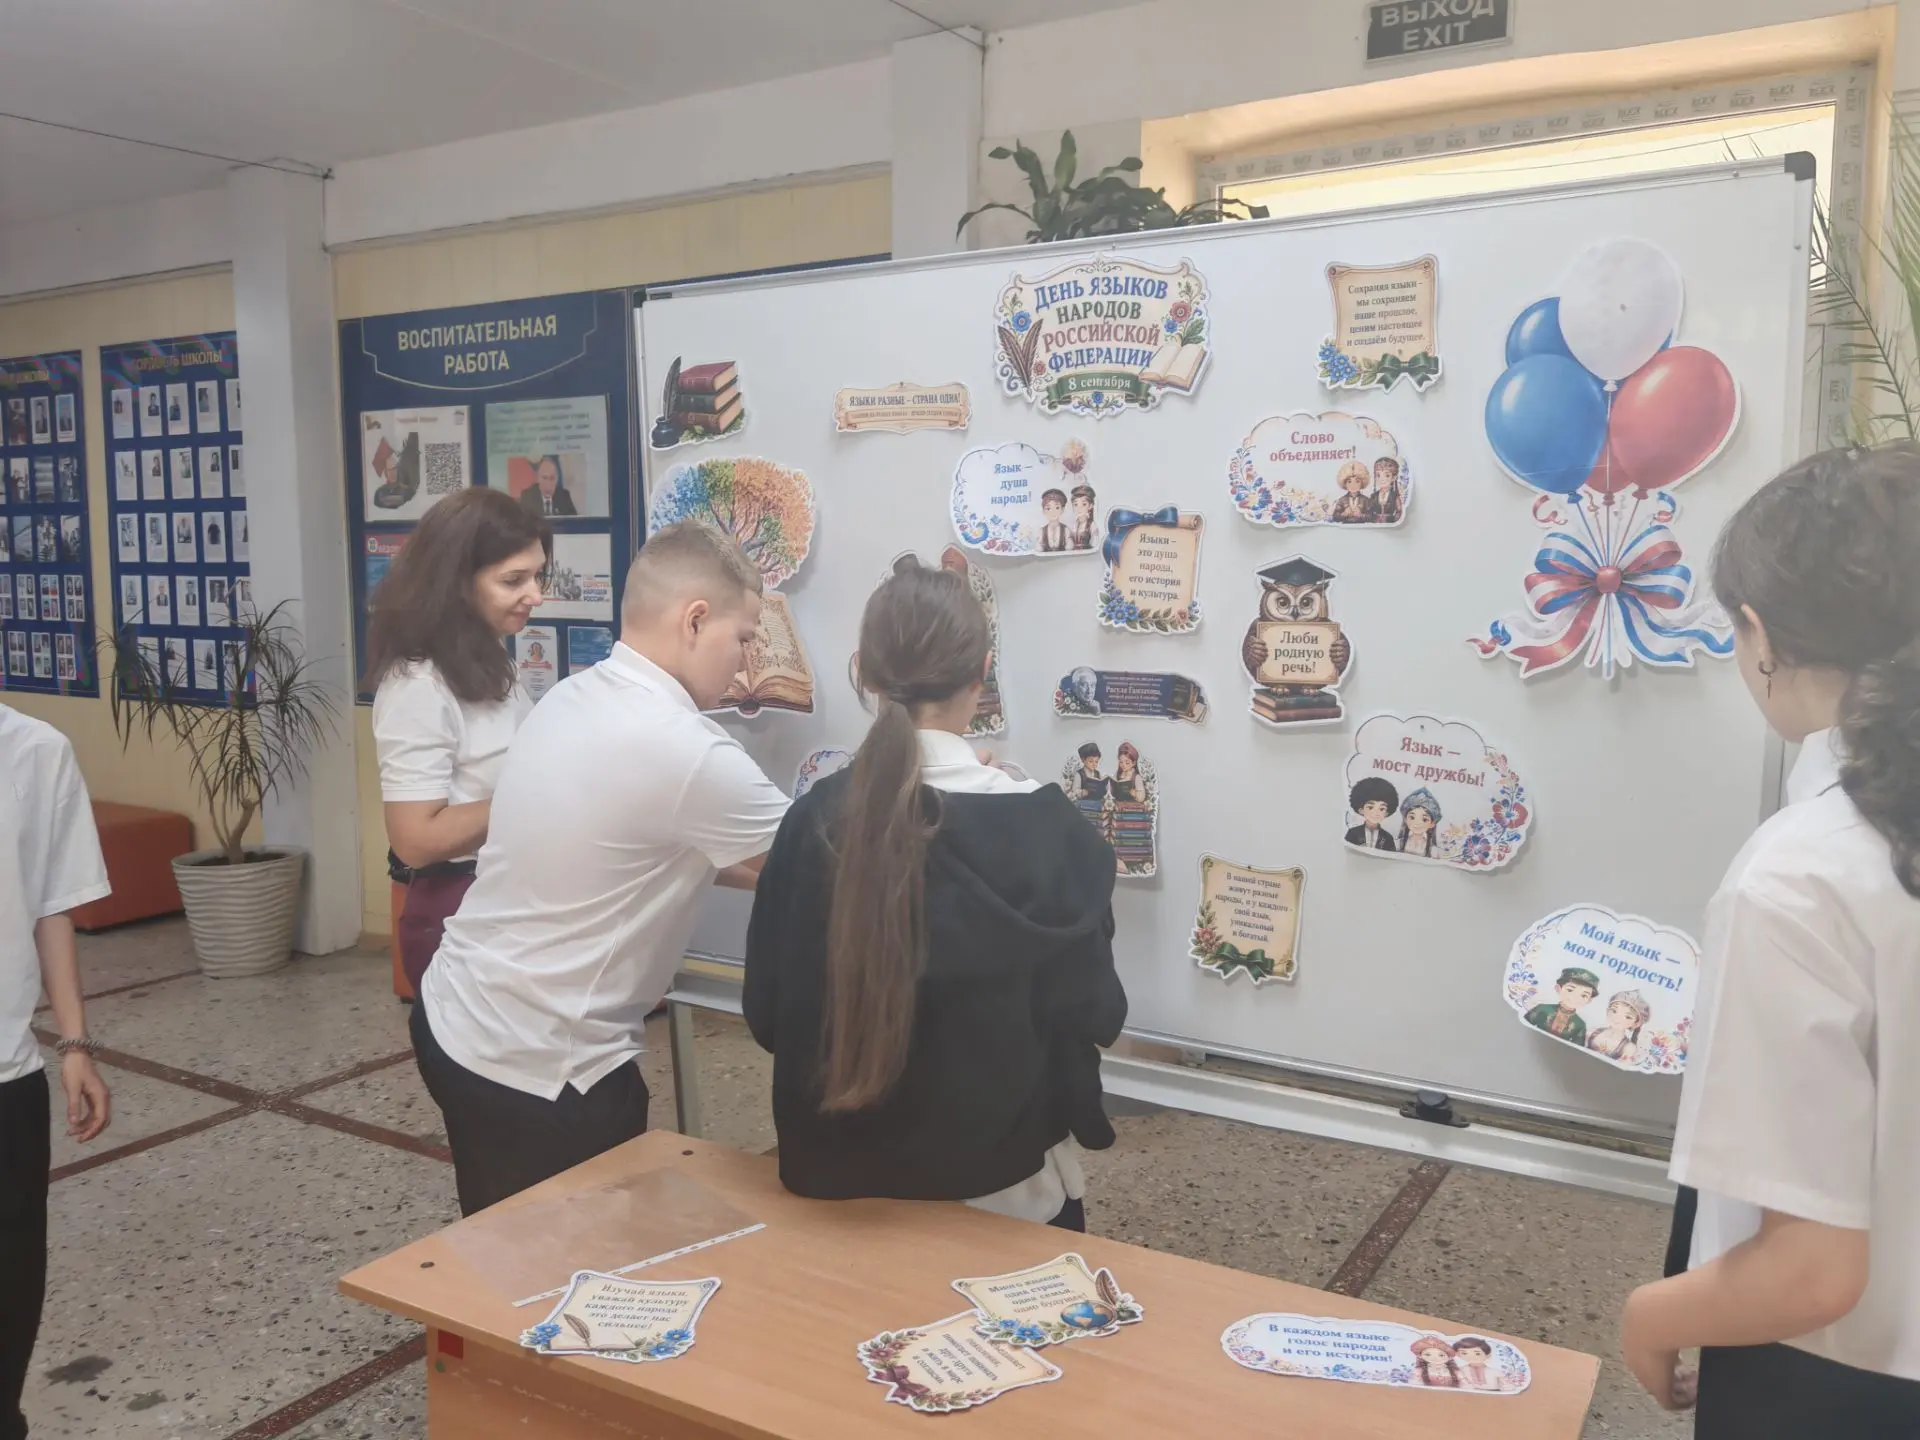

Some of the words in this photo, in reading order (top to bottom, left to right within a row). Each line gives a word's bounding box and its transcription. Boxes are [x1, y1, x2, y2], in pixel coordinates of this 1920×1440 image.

[1381, 0, 1495, 27] ВЫХОД
[1403, 20, 1471, 50] EXIT
[1034, 279, 1084, 312] ДЕНЬ
[1089, 277, 1168, 299] ЯЗЫКОВ
[1372, 294, 1416, 306] сохраняем
[1056, 301, 1142, 324] НАРОДОВ
[398, 315, 557, 351] ВОСПИТАТЕЛЬНАЯ
[1350, 324, 1376, 333] ценим
[1378, 321, 1422, 331] настоящее
[1042, 322, 1160, 353] РОССИЙСКОЙ
[182, 350, 222, 365] ШКОЛЫ
[444, 350, 509, 375] РАБОТА
[1048, 348, 1153, 372] ФЕДЕРАЦИИ
[1068, 377, 1077, 390] 8
[1081, 375, 1131, 391] сентября
[850, 396, 876, 406] ЯЗЫКИ
[878, 396, 905, 405] РАЗНЫЕ
[912, 394, 938, 404] СТРАНА
[940, 393, 960, 404] ОДНА!
[1291, 431, 1334, 445] Слово
[1270, 445, 1356, 462] объединяет!
[994, 464, 1022, 474] Язык
[1000, 479, 1028, 490] душа
[991, 491, 1032, 506] народа!
[1140, 533, 1169, 544] Языки
[1154, 550, 1178, 560] душа
[1140, 563, 1173, 573] народа,
[1280, 631, 1318, 644] Люби
[1274, 648, 1324, 661] родную
[1282, 662, 1316, 676] речь!
[1400, 736, 1443, 756] Язык
[1372, 758, 1411, 773] мост
[1415, 764, 1485, 787] дружбы!
[1258, 879, 1281, 888] стране
[1252, 889, 1278, 899] разные
[1580, 922, 1615, 944] Мой
[1618, 939, 1662, 962] язык
[1564, 941, 1596, 960] моя
[1600, 953, 1683, 991] гордость!
[601, 1284, 645, 1295] Изучай
[1269, 1324, 1278, 1332] В
[1283, 1327, 1341, 1337] каждом
[1346, 1332, 1390, 1341] языке
[1288, 1338, 1328, 1347] голос
[1332, 1341, 1386, 1352] народа
